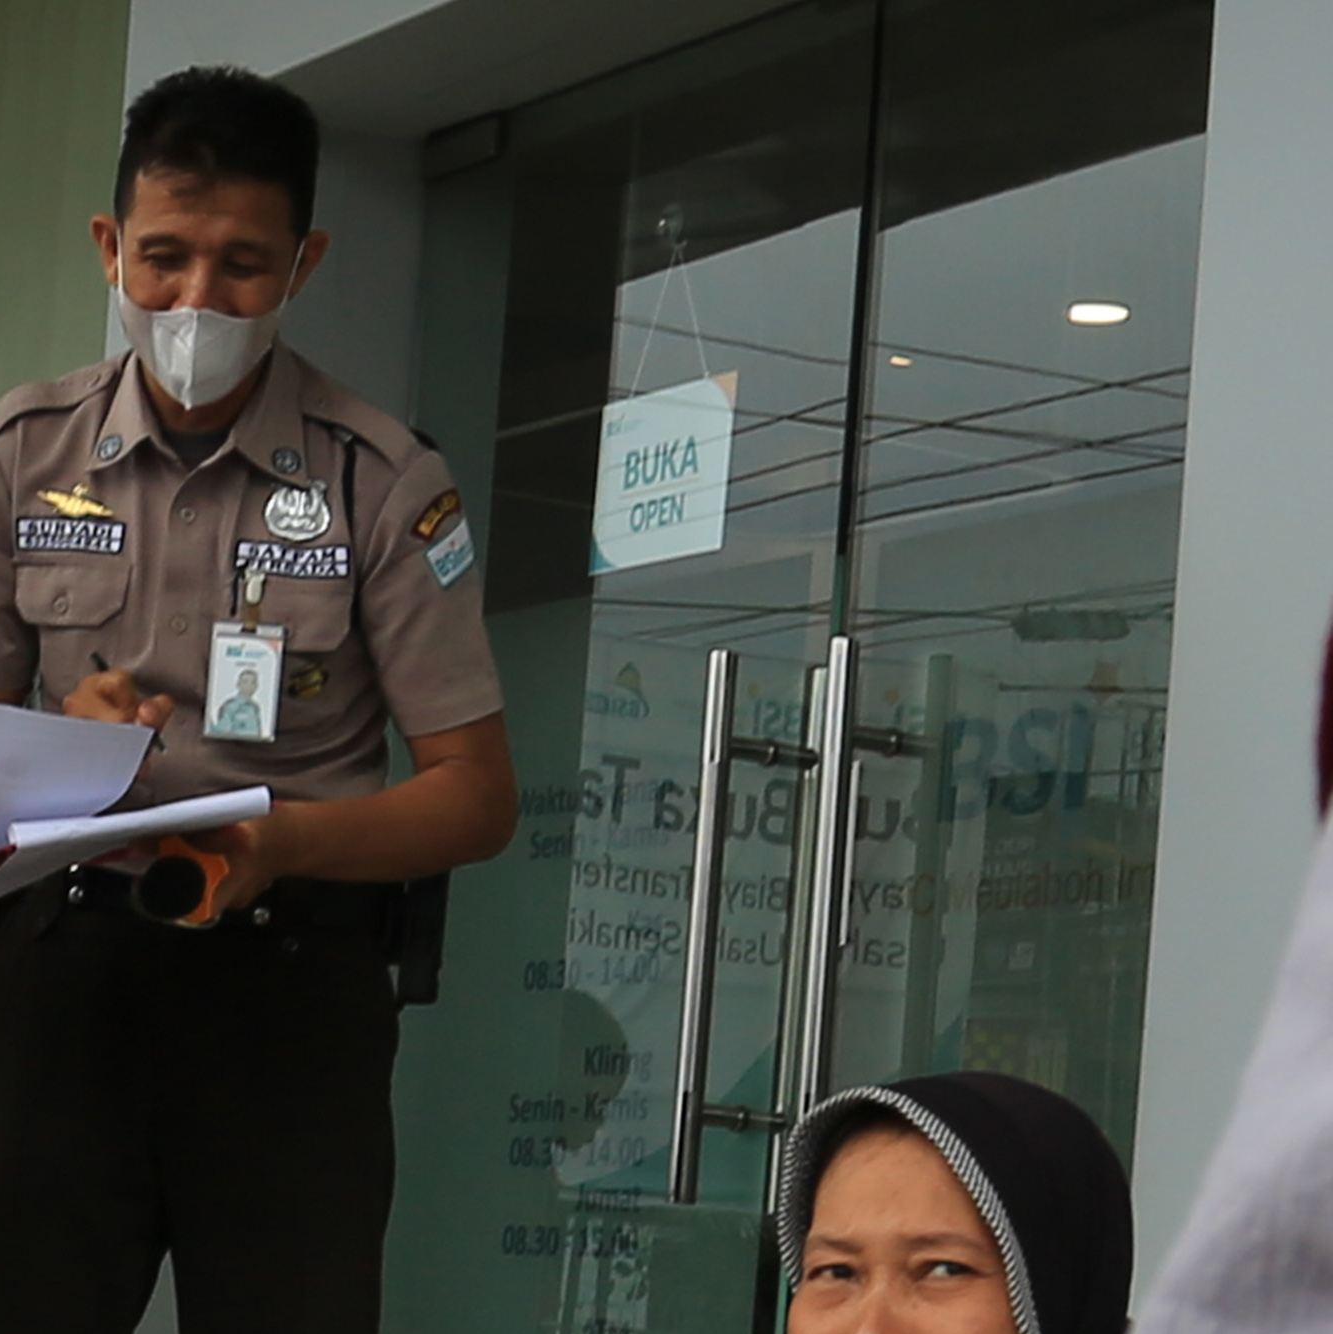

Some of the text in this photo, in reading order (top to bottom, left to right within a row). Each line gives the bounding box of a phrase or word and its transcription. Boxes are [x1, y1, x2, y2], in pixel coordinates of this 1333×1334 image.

[623, 435, 699, 491] BUKA
[629, 492, 686, 533] OPEN
[523, 957, 581, 990] 08.30
[601, 953, 661, 986] 14.00
[585, 1044, 653, 1082] Kliring
[509, 1091, 564, 1123] Senin
[585, 1091, 649, 1122] Kamis
[508, 1135, 565, 1168] 08.30
[501, 1223, 560, 1256] 08.30
